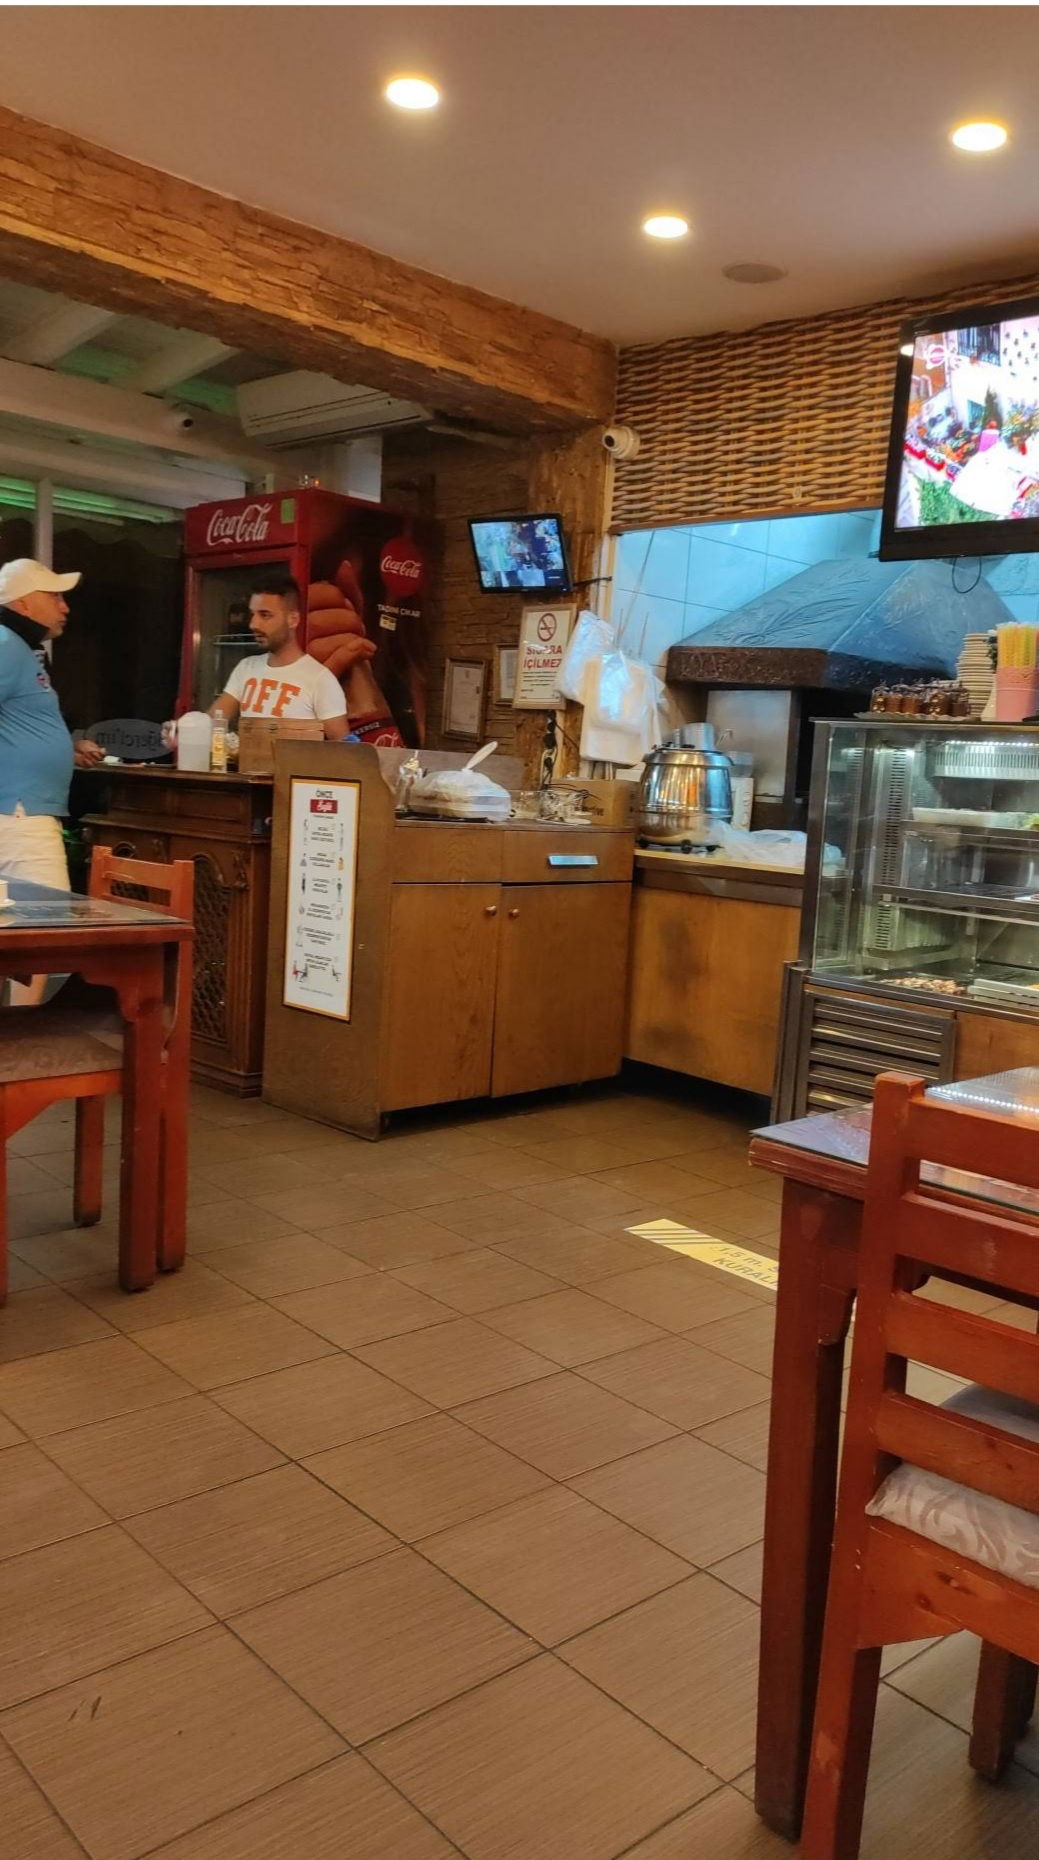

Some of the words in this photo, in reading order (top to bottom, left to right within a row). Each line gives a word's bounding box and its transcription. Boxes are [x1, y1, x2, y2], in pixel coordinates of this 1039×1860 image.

[206, 503, 273, 546] Coca-Cola
[381, 555, 421, 578] Coca-Cola
[240, 677, 301, 717] OFF
